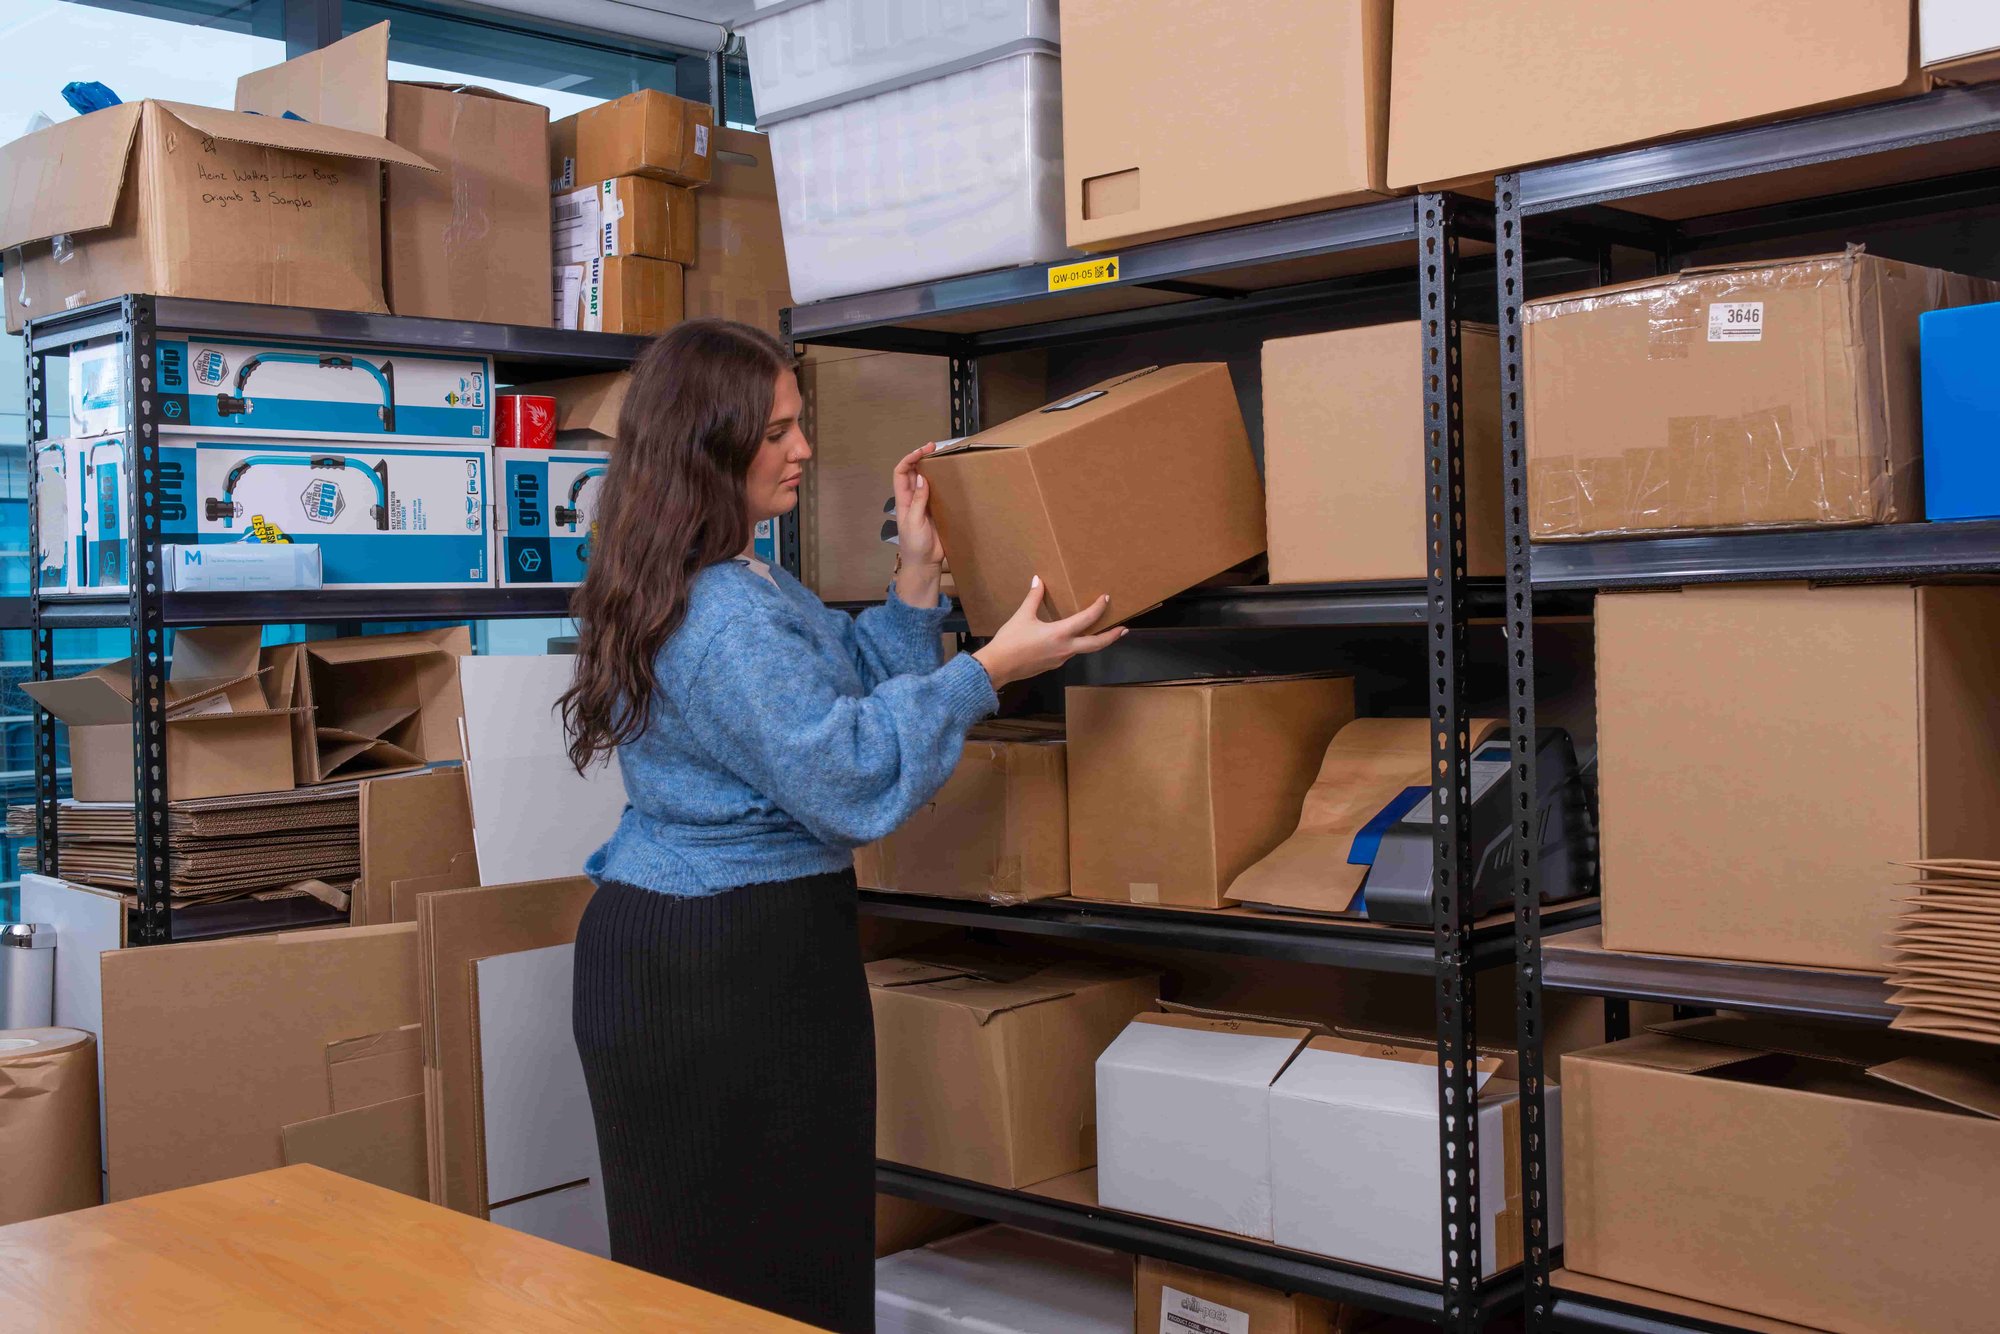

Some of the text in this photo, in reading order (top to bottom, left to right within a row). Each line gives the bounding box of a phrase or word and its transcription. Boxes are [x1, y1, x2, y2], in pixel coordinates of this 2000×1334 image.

[197, 162, 228, 181] Heinz
[281, 167, 307, 180] Liner
[604, 222, 613, 251] BLUE
[1053, 269, 1093, 284] QW-01-05
[590, 286, 599, 317] DART
[1727, 308, 1760, 323] 3646
[161, 348, 181, 387] grip
[200, 352, 211, 382] CONTROL
[207, 352, 222, 382] grip
[159, 461, 187, 522] grip
[309, 482, 322, 518] CONTROL
[317, 482, 337, 518] grip
[515, 473, 541, 527] grip
[185, 550, 202, 566] M
